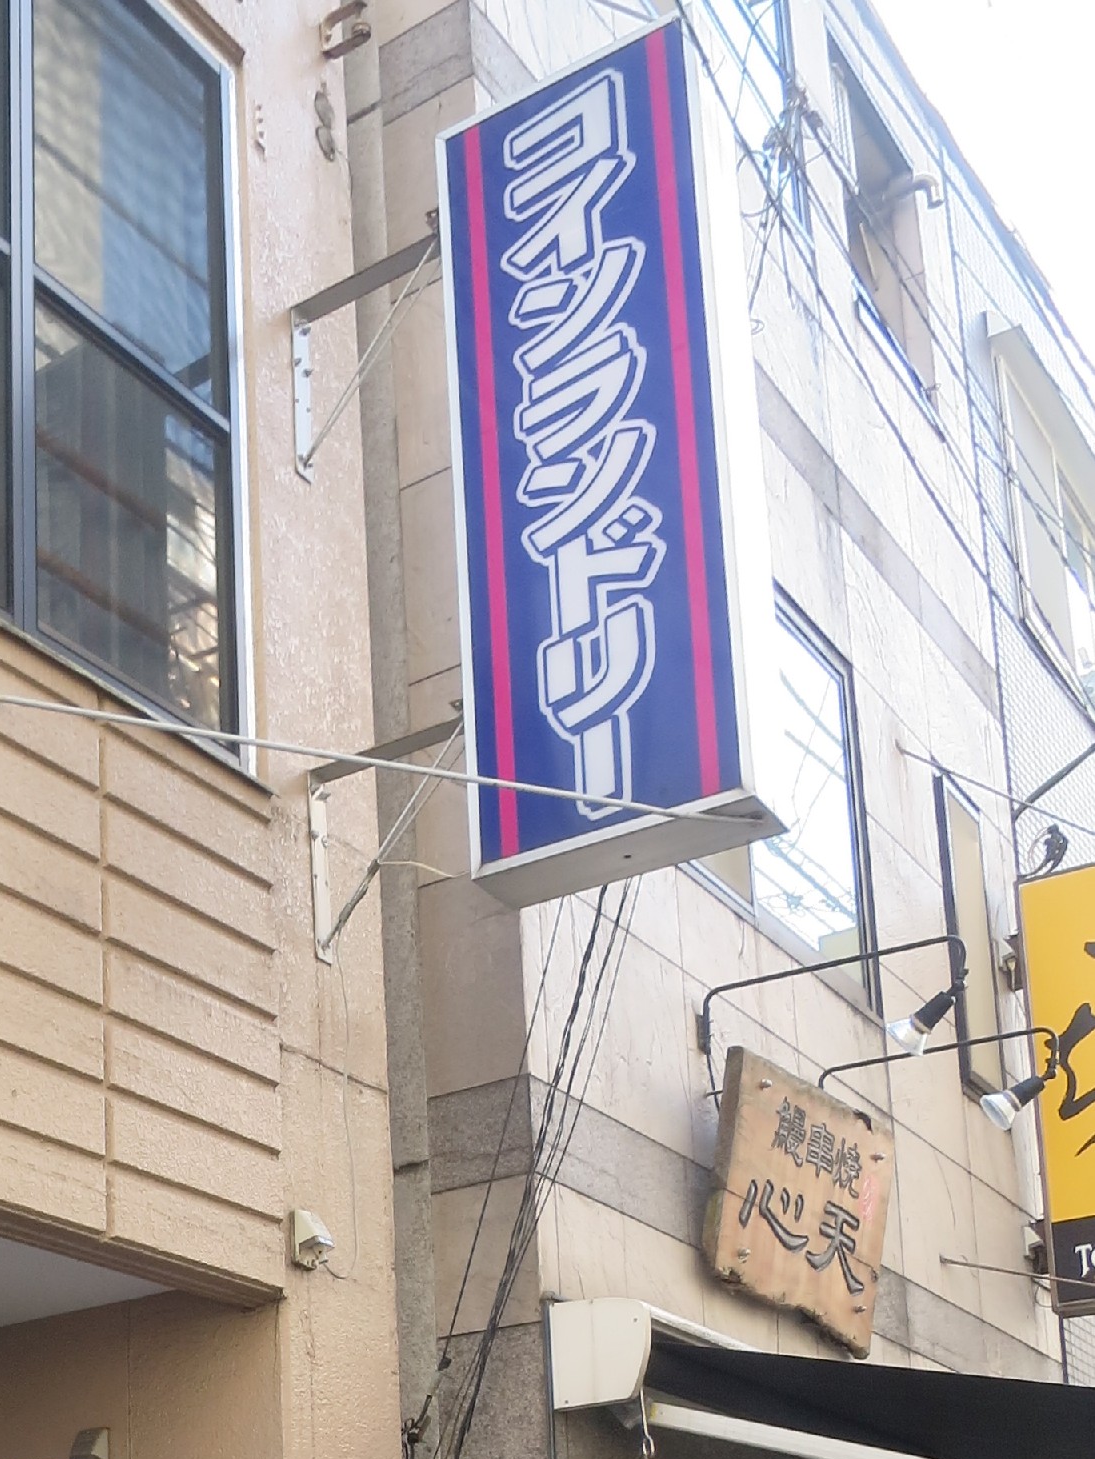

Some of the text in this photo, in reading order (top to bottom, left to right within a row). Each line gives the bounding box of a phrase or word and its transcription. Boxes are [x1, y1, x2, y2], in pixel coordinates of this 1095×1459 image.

[502, 67, 666, 819] コインランドリー
